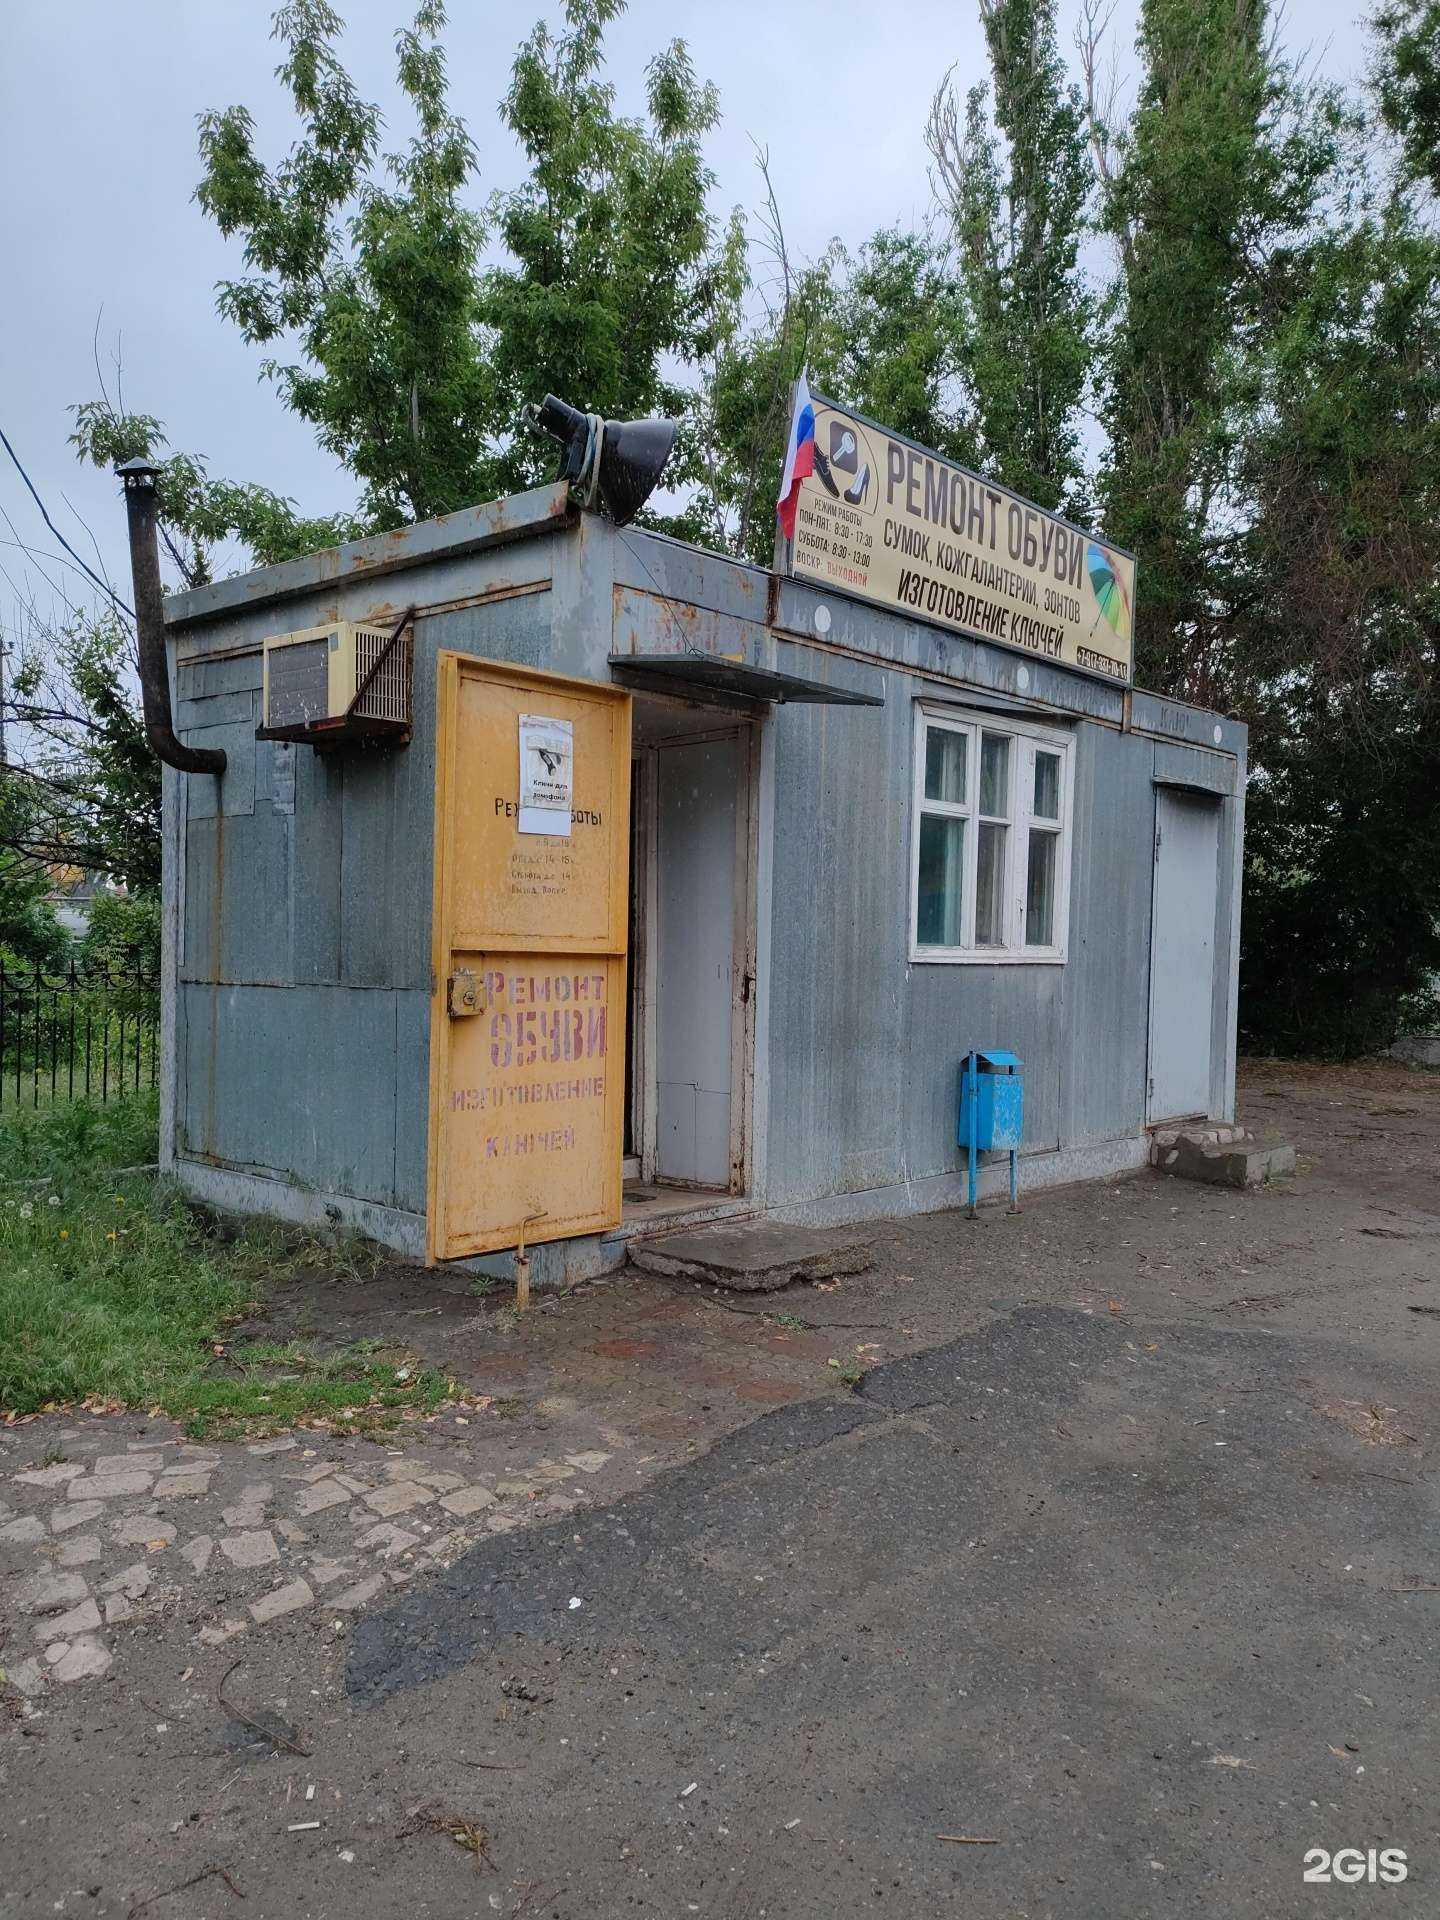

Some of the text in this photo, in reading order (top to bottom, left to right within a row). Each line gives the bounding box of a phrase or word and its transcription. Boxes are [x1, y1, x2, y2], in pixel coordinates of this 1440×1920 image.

[814, 498, 863, 527] РЕЖИМ РАБОТЫ
[887, 440, 1085, 591] РЕМОНТ ОБУВИ
[798, 530, 830, 553] СУББОТА:
[827, 560, 868, 588] ВЫХОДНОЙ
[883, 518, 1081, 624] СУМОК, КОЖГАЛАНТЕРИИ, ЗОНТОВ
[897, 568, 1065, 659] ИЗГОТОВЛЕНИЕ КЛЮЧЕЙ
[485, 971, 605, 1006] РЕМОНТ
[490, 1006, 606, 1067] ОБУВИ
[452, 1077, 604, 1113] ИЗГОТОВЛЕНИЕ
